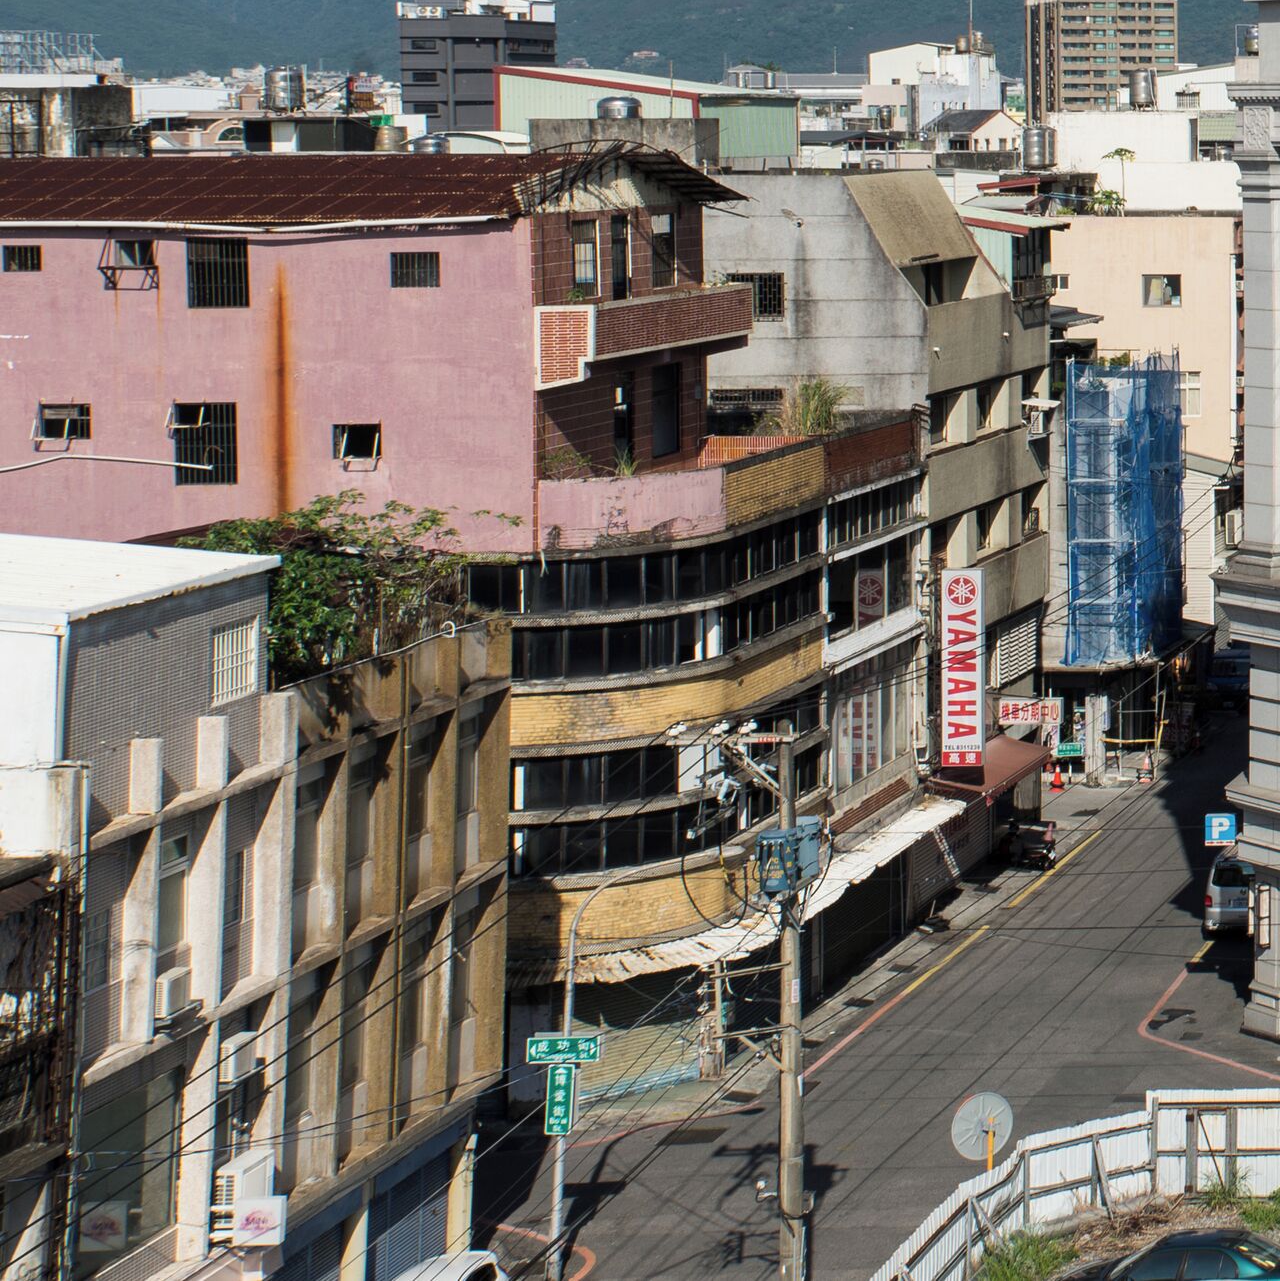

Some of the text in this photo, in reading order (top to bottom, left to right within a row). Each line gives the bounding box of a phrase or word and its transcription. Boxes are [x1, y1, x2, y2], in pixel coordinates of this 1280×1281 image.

[948, 610, 976, 739] YAMAHA
[1001, 701, 1060, 723] 機車分期中心
[1211, 817, 1230, 839] P
